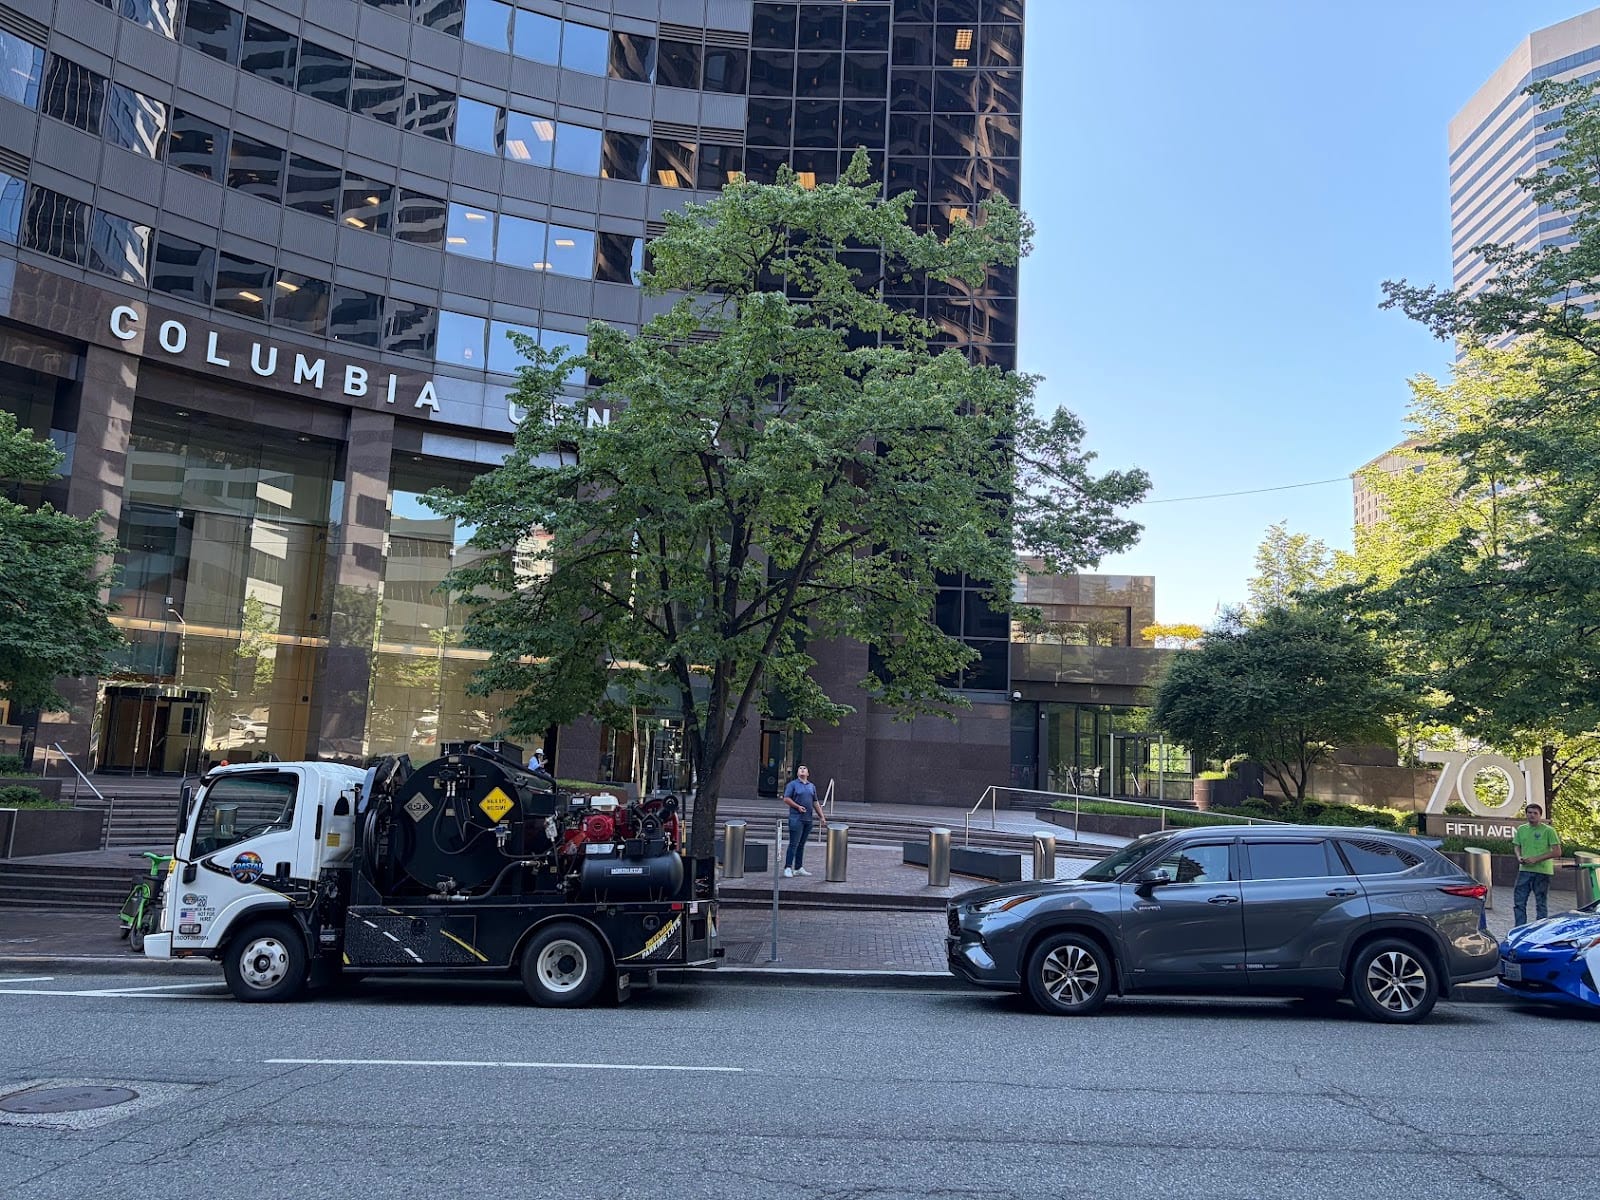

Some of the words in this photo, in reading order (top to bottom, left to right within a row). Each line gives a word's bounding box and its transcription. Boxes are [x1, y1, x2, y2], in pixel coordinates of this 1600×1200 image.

[109, 305, 441, 413] COLUMBIA
[1419, 751, 1547, 819] 701
[1446, 823, 1483, 836] FIFTH
[1486, 825, 1519, 838] AVEN
[231, 862, 264, 872] COASTAL
[641, 935, 667, 960] PARKING
